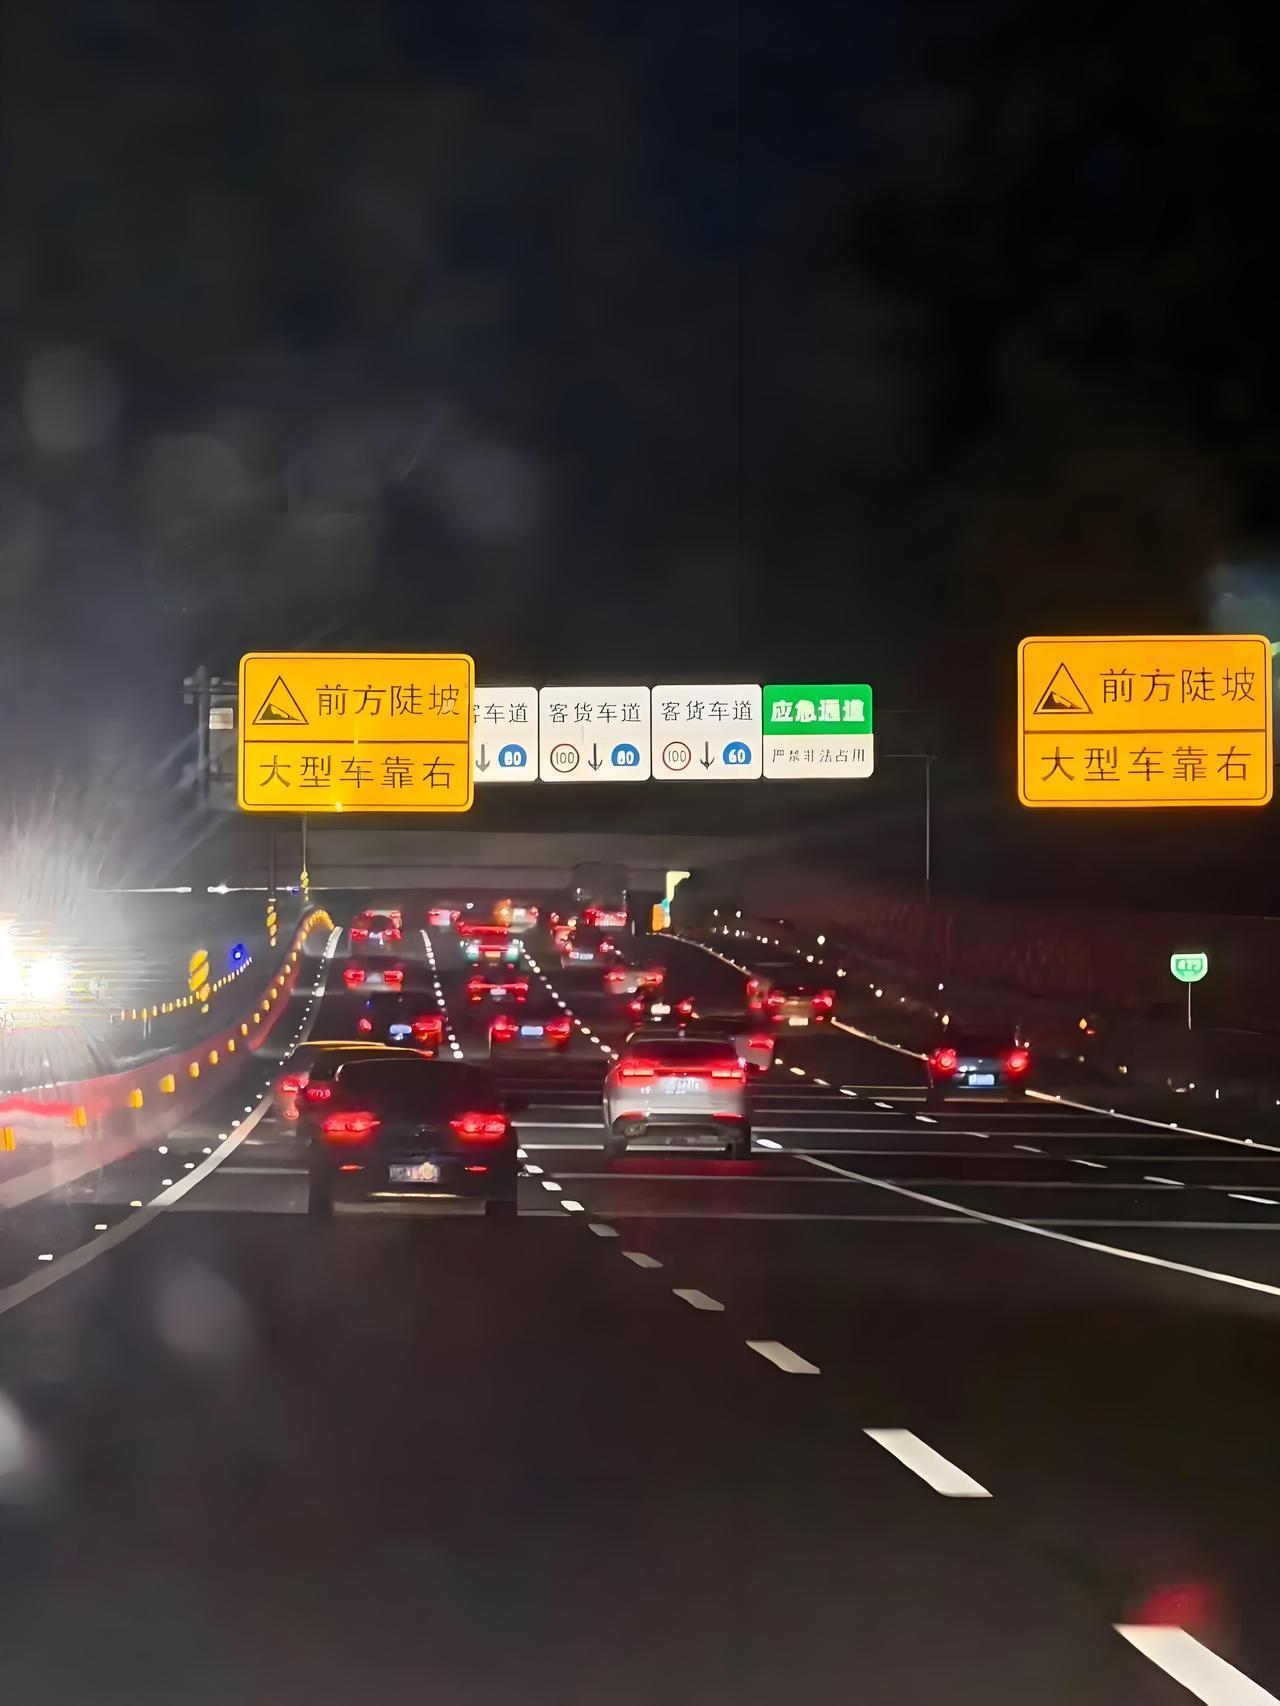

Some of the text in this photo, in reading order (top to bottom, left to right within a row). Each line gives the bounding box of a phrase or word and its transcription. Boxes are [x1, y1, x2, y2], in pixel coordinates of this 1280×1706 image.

[1099, 666, 1256, 704] 前方陡坡
[315, 683, 461, 717] 前方陡坡
[660, 699, 754, 722] 客货车道
[549, 701, 642, 724] 客货车道
[555, 751, 576, 765] 100
[667, 750, 688, 764] 100
[727, 748, 747, 764] 60
[1040, 745, 1253, 782] 大型车靠右
[259, 754, 455, 789] 大型车靠右
